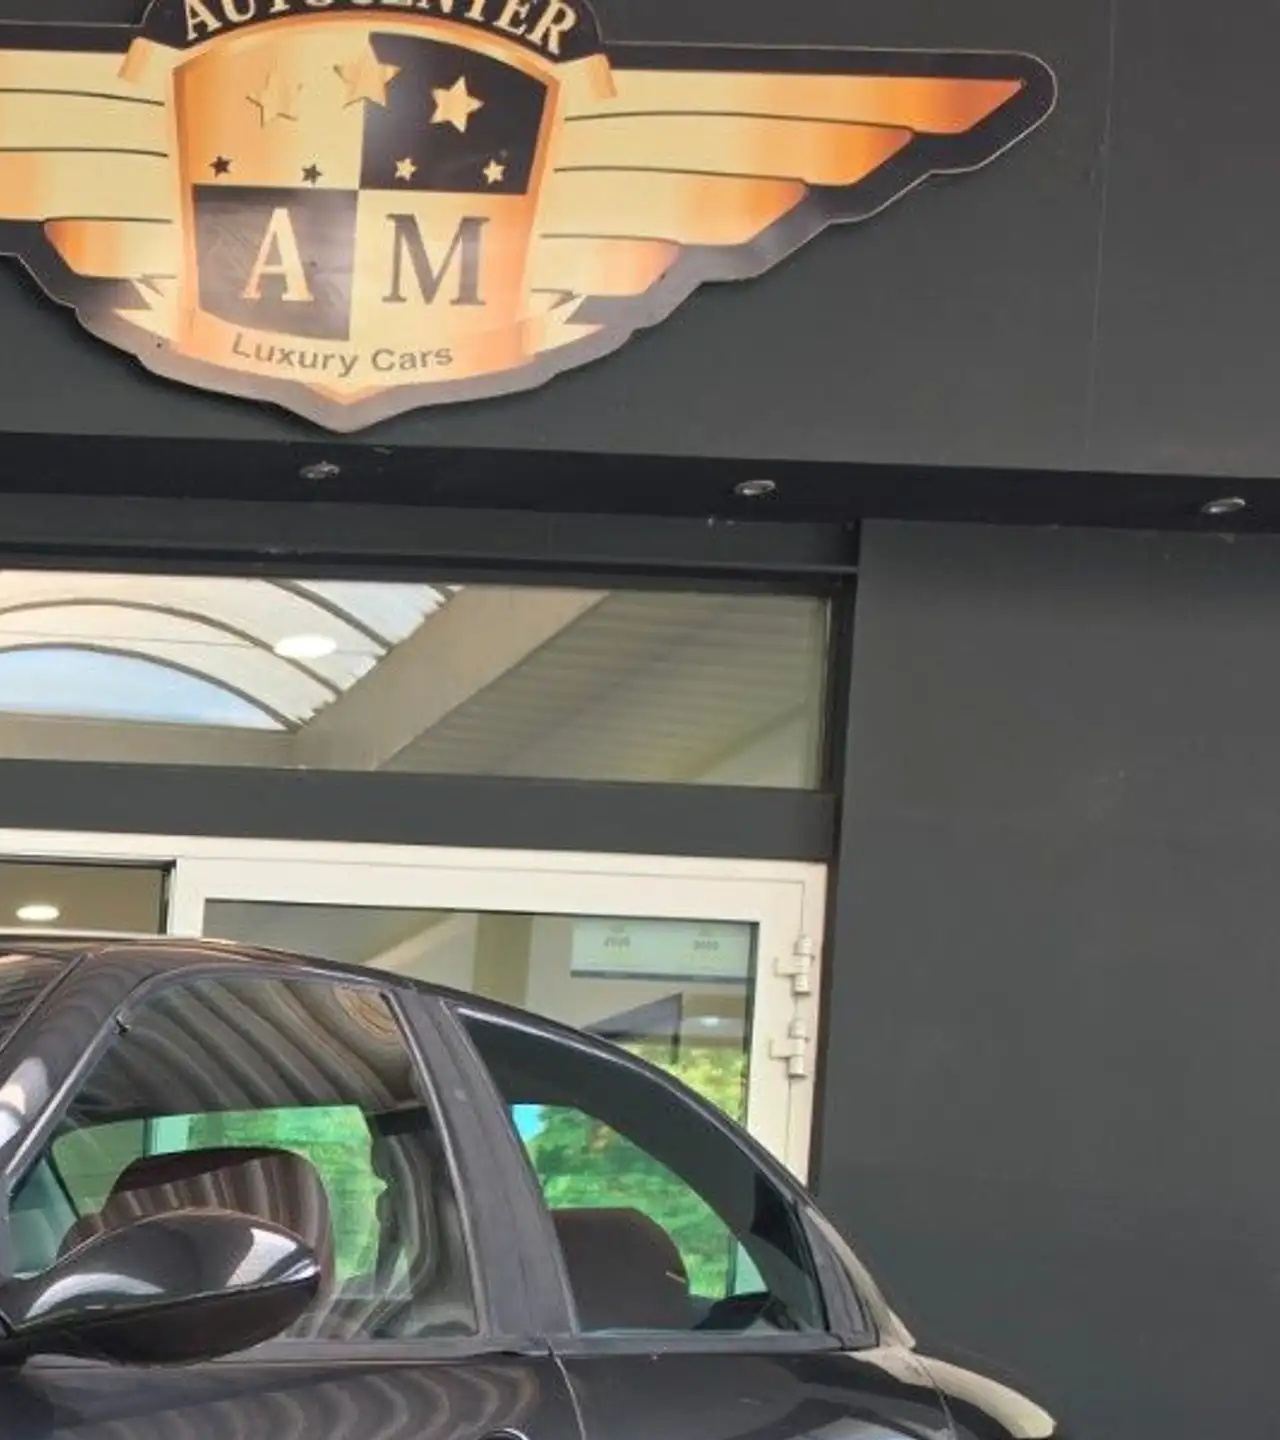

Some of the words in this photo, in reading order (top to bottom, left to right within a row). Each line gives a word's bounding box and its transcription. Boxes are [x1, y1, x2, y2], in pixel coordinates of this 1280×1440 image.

[241, 207, 314, 302] A
[382, 213, 491, 306] M
[232, 332, 359, 378] Luxury
[371, 347, 454, 372] Cars
